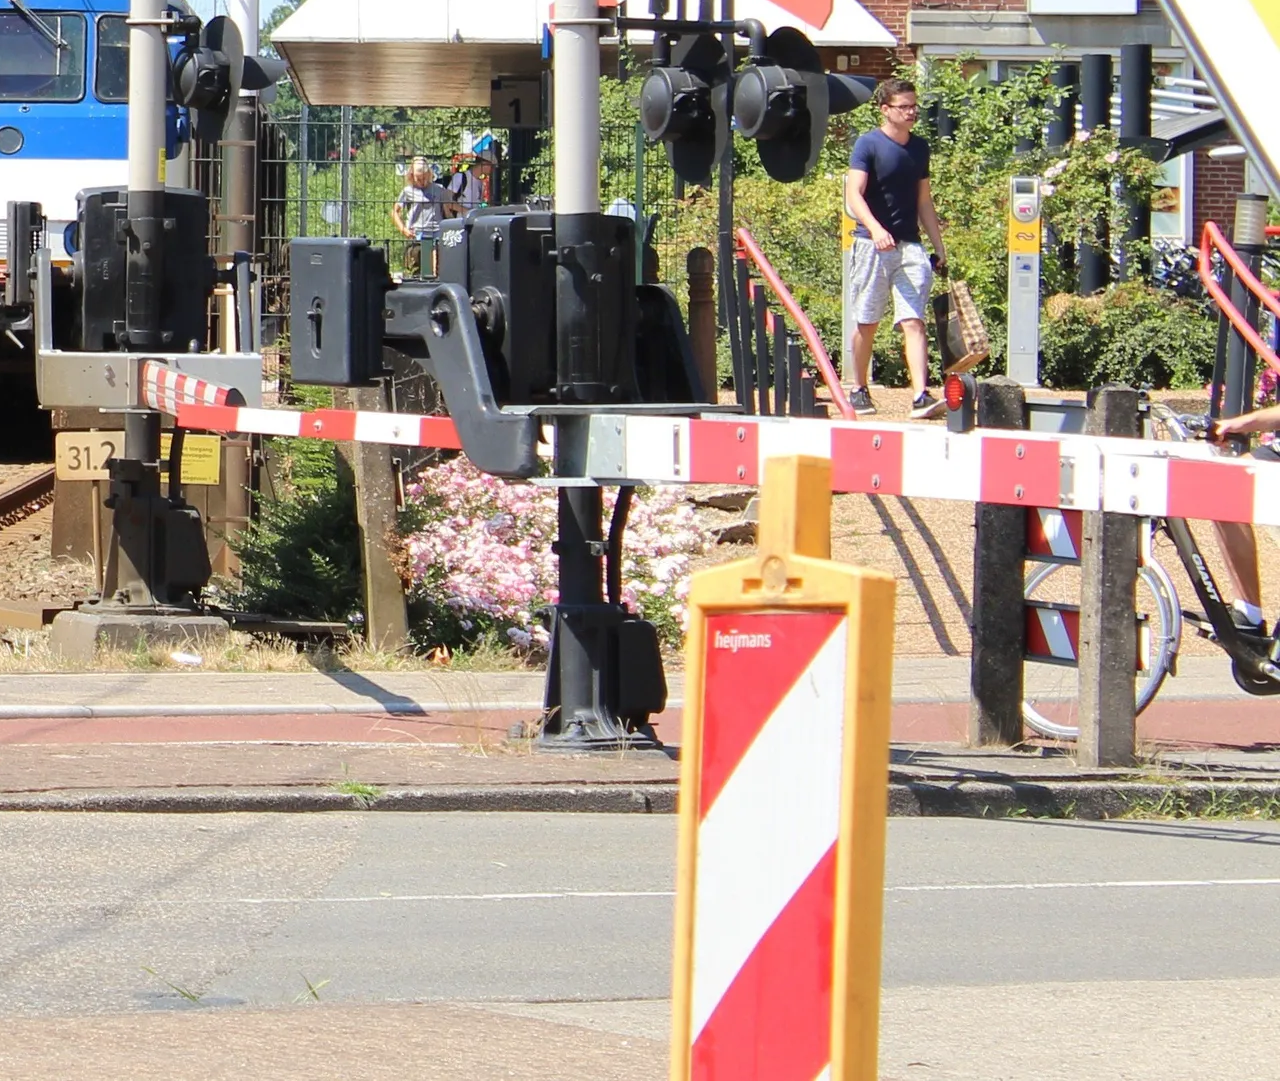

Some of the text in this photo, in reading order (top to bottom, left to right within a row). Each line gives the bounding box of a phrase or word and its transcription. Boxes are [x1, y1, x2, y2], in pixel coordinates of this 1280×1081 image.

[508, 98, 521, 124] 1
[68, 441, 116, 471] 31.2
[1192, 553, 1220, 602] GIANT
